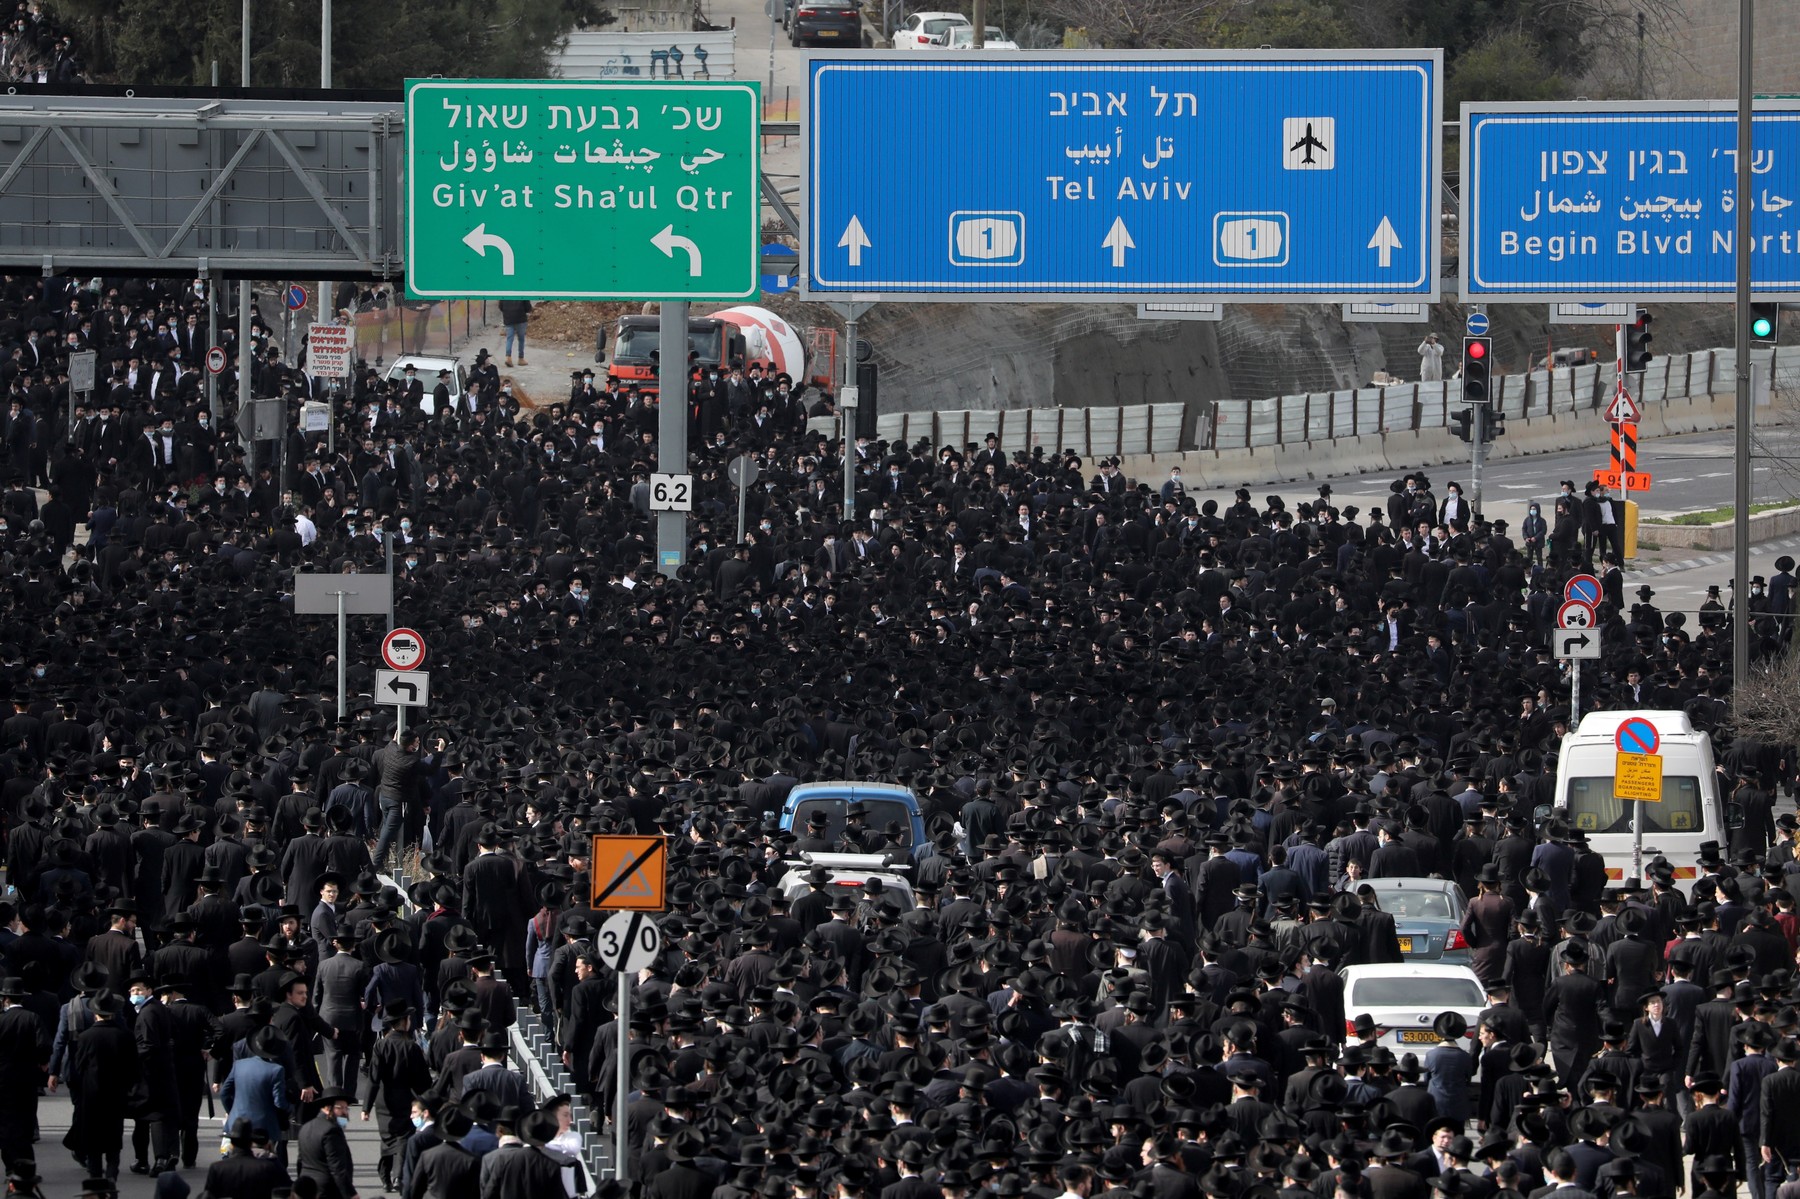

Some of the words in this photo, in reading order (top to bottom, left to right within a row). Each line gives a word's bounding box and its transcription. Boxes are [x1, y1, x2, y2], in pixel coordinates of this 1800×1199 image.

[442, 97, 528, 128] שאול
[1050, 92, 1128, 116] אביב
[1150, 86, 1197, 117] תל
[548, 104, 639, 133] גבעת
[661, 104, 722, 131] שכ'
[439, 140, 533, 172] شاؤول
[1065, 126, 1123, 165] أبيب
[1142, 135, 1174, 169] تل
[680, 148, 725, 175] حي
[1540, 150, 1608, 182] צפון
[1629, 150, 1689, 181] בגין
[432, 183, 533, 207] Giv'at
[554, 184, 657, 209] Sha'ul
[676, 186, 733, 212] Qtr
[1046, 176, 1095, 200] Tel
[1117, 176, 1192, 200] Aviv
[1520, 189, 1601, 222] شمال
[1619, 195, 1702, 223] بيچين
[1721, 189, 1793, 219] جاة
[982, 227, 993, 250] 1
[1246, 228, 1257, 250] 1
[1501, 231, 1597, 261] Begin
[1617, 230, 1692, 254] Blvd
[1712, 230, 1800, 254] Nrt
[654, 483, 687, 502] 6.2
